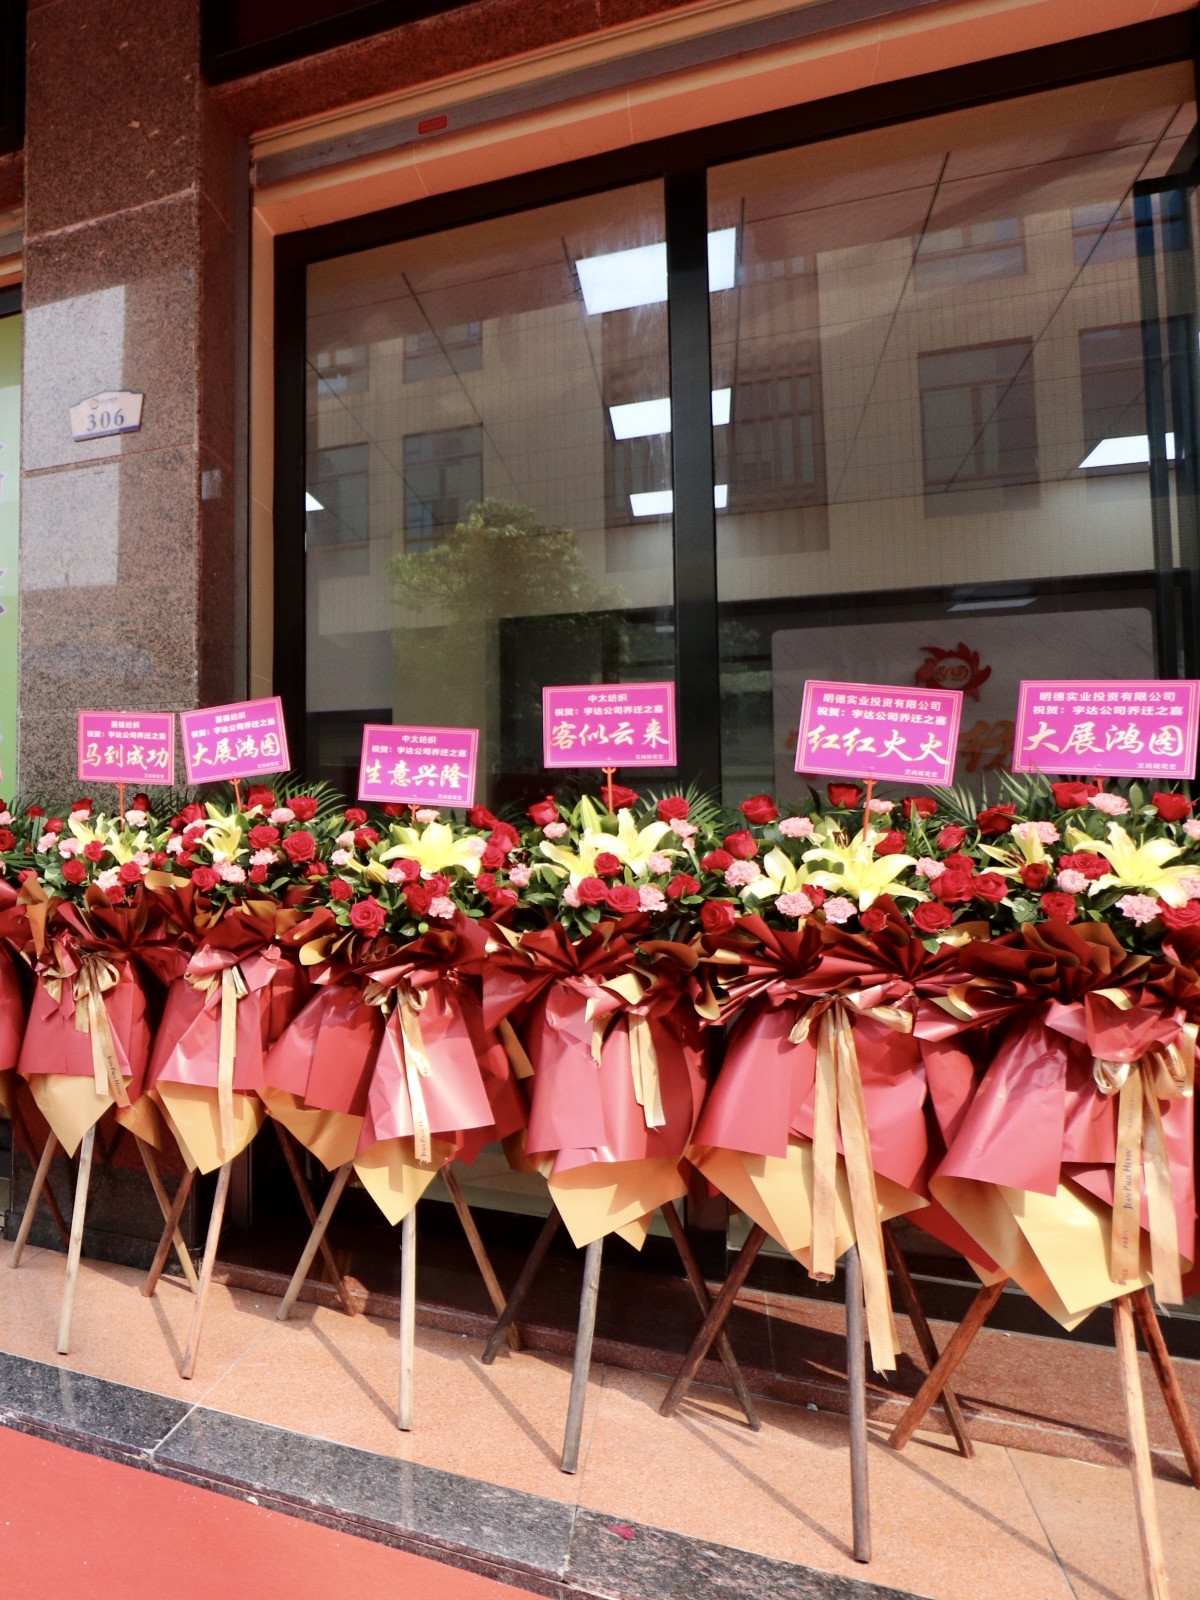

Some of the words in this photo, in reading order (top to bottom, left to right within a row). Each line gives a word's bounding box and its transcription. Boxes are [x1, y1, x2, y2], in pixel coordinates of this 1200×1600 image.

[86, 408, 125, 431] 306
[822, 692, 942, 712] 明德实业投资有限公司
[1039, 691, 1176, 702] 明德实业投资有限公司
[551, 718, 670, 750] 客似云来
[807, 724, 950, 765] 红红火火
[1022, 720, 1184, 757] 大展鸿图
[82, 742, 170, 770] 马到成功
[191, 732, 281, 767] 大展鸿图
[365, 759, 469, 788] 生意兴隆
